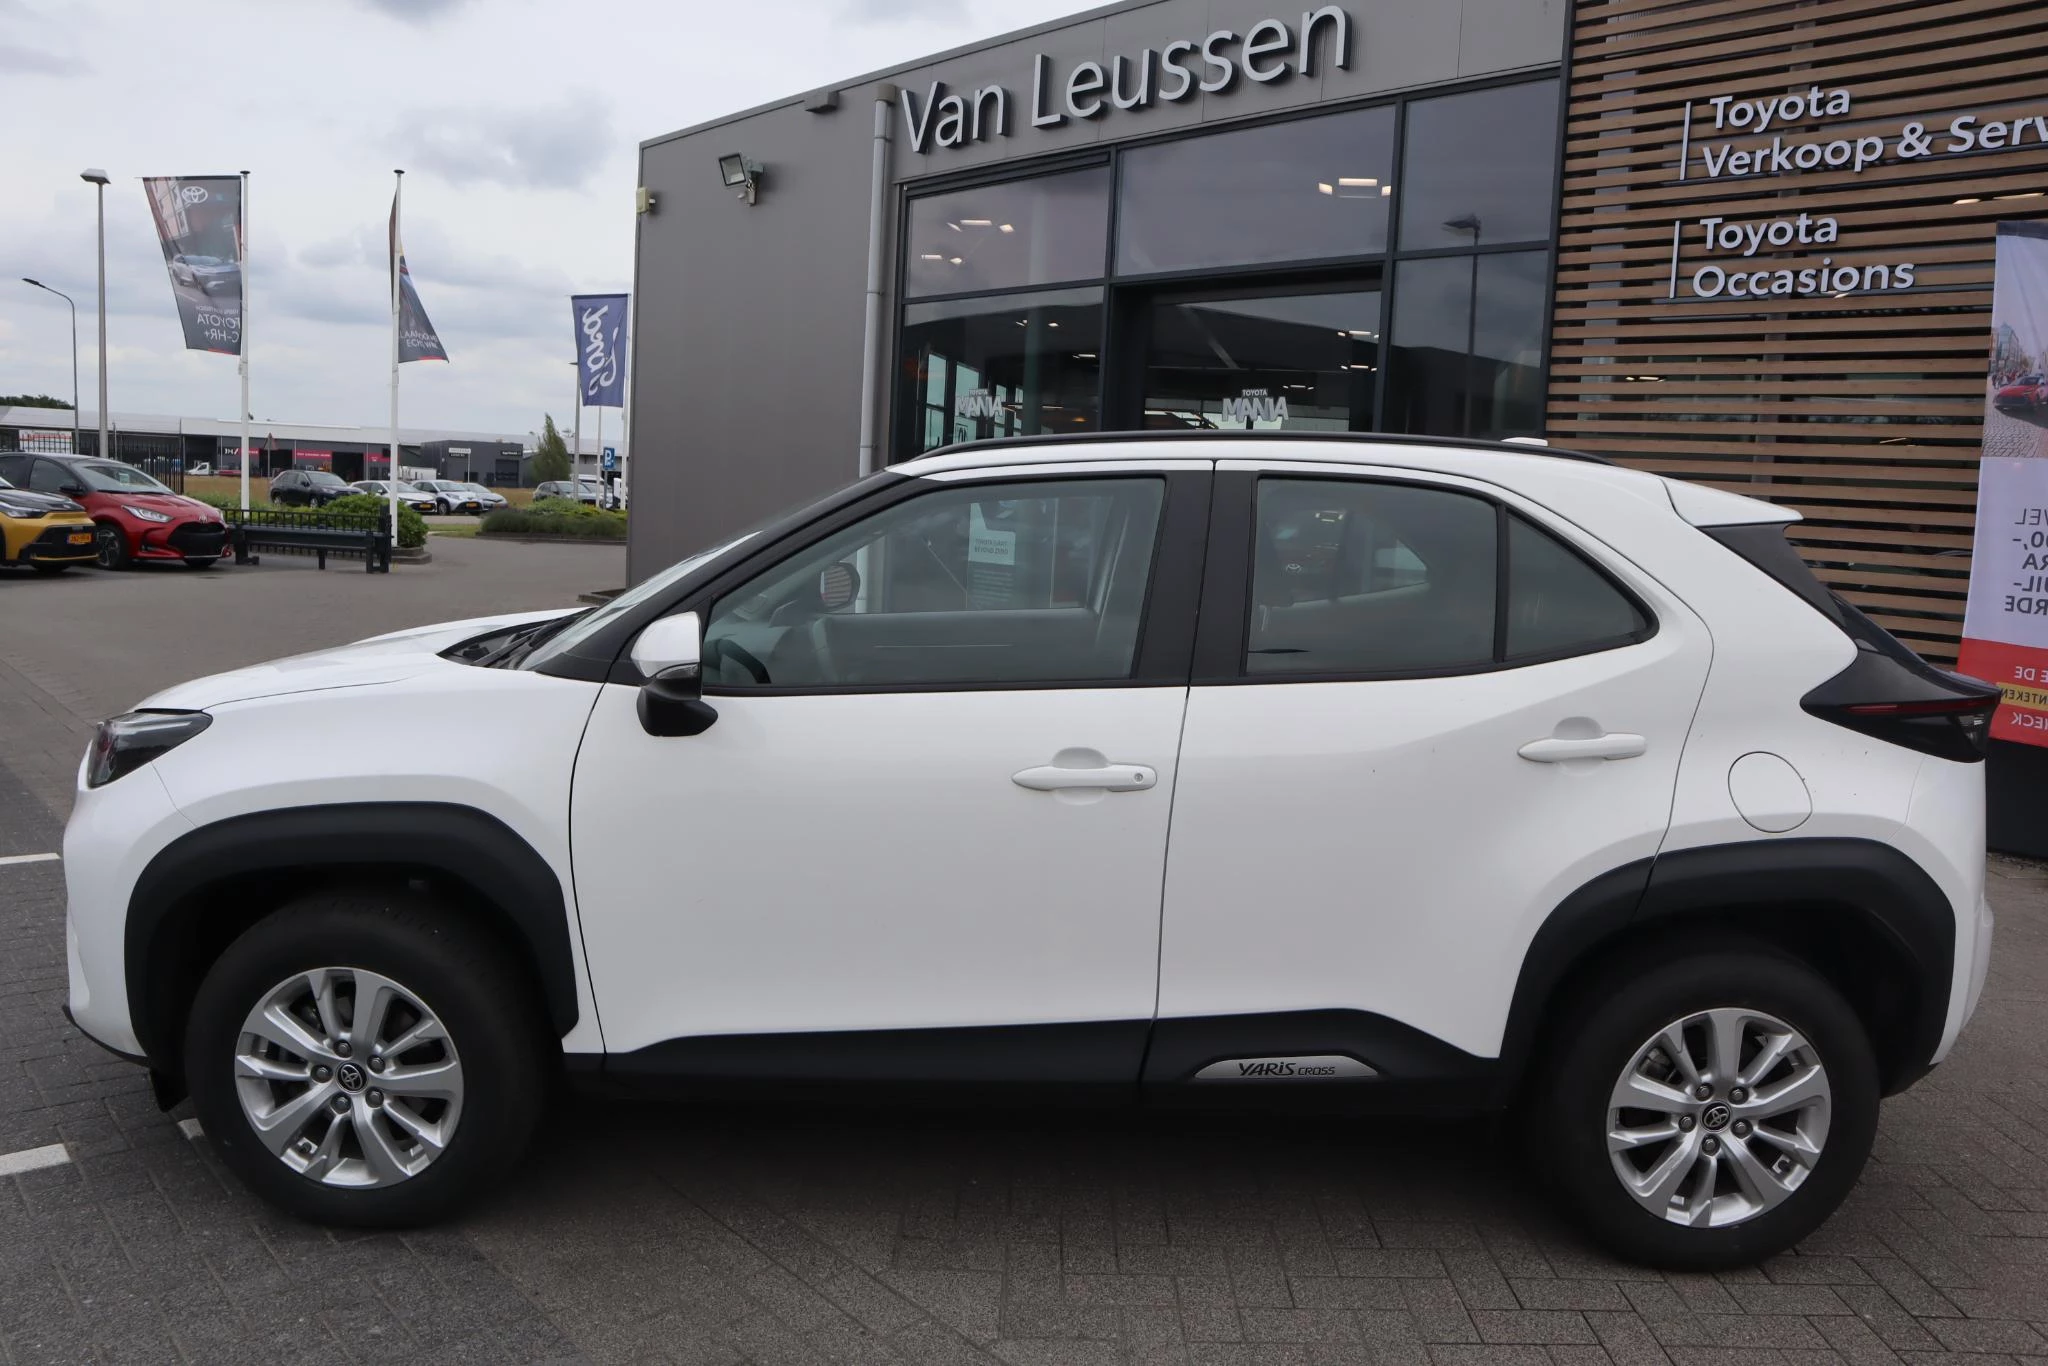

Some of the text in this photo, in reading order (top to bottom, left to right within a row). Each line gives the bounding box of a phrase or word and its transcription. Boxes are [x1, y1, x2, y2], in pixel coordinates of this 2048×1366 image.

[901, 5, 1350, 154] Van Leussen
[1710, 86, 1851, 133] Toyota
[1703, 136, 1884, 178] Verkoop
[1896, 122, 1932, 158] &
[1700, 213, 1838, 256] Toyota
[1693, 257, 1915, 298] Occasions
[955, 395, 1003, 417] MANIA
[1222, 396, 1289, 423] MANIA
[1242, 388, 1268, 396] TOYOTA
[1298, 1065, 1335, 1076] CROSS
